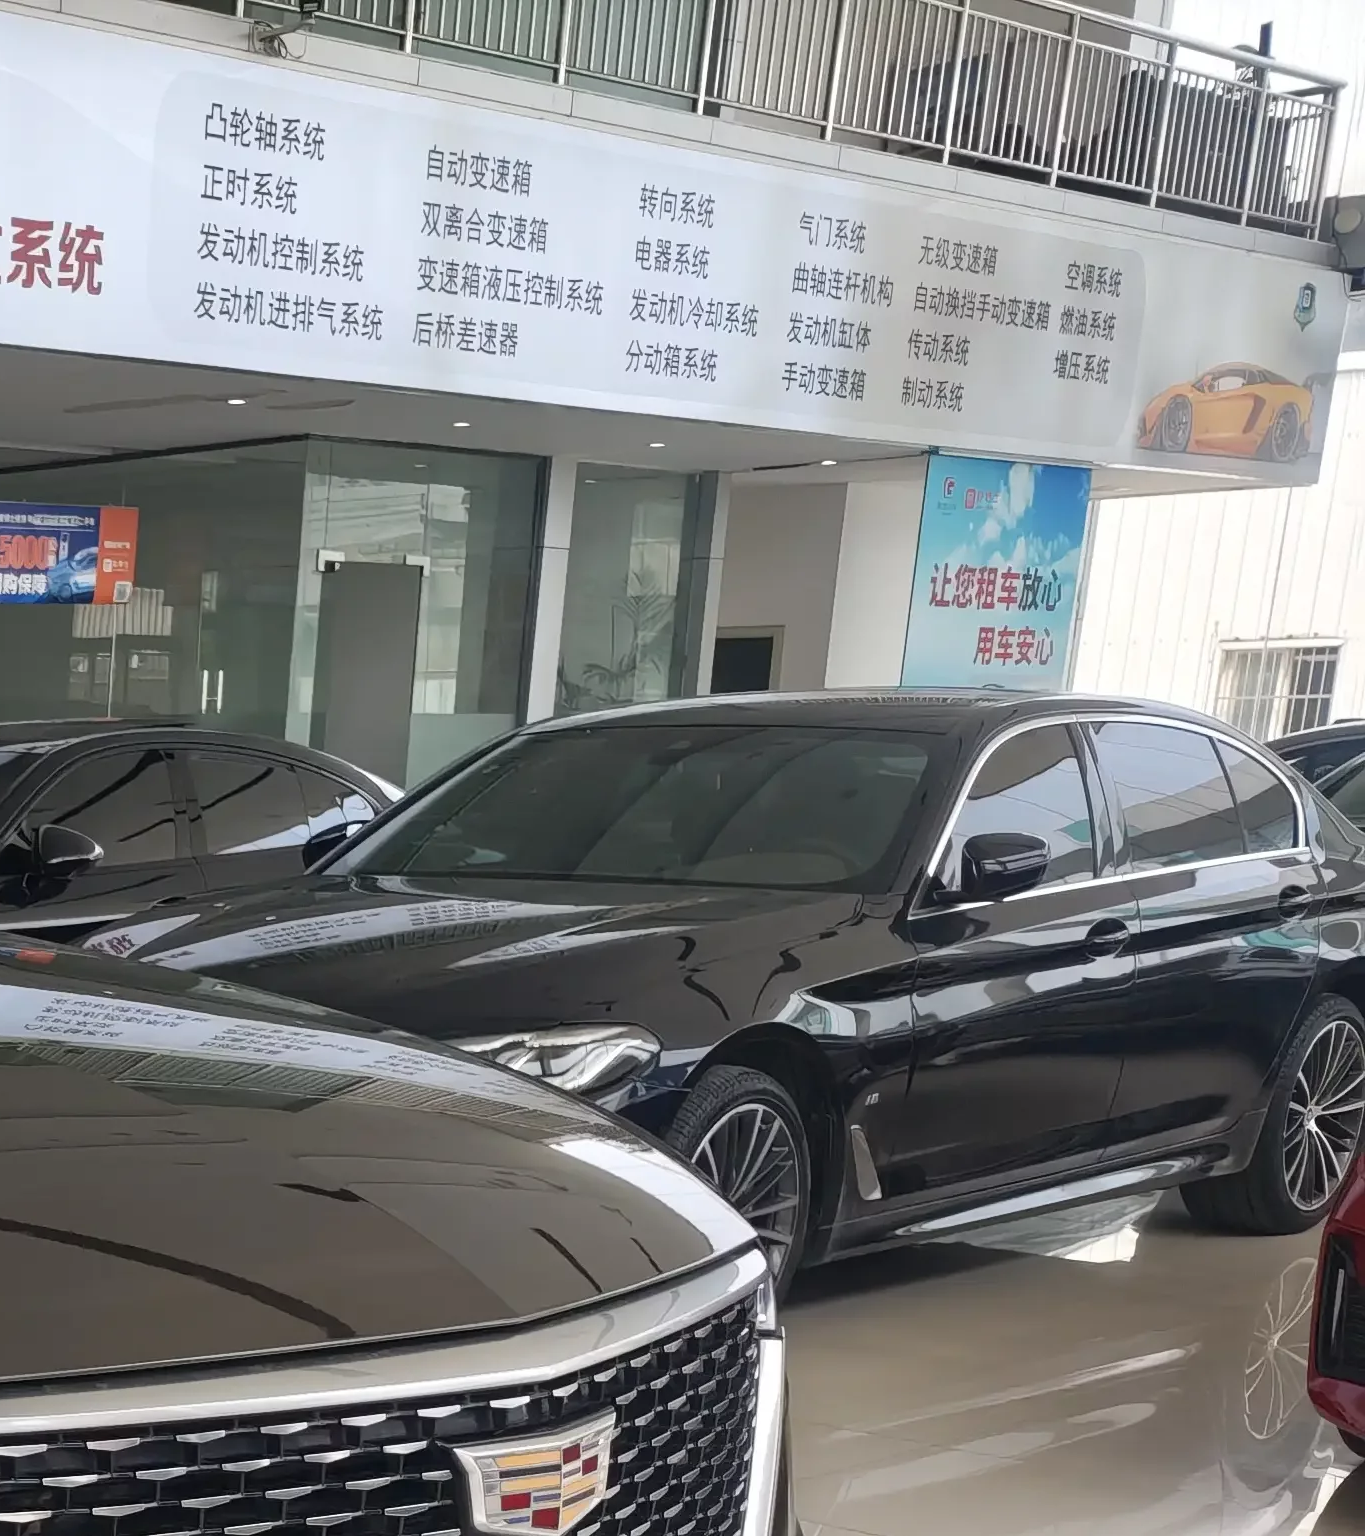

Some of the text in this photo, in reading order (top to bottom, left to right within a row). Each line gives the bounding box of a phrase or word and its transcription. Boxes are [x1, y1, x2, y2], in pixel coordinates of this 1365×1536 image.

[204, 103, 326, 163] 凸轮轴系统
[201, 165, 298, 216] 正时系统
[425, 145, 533, 198] 自动变速箱
[421, 202, 549, 255] 双离合变速箱
[639, 183, 715, 229] 转向系统
[197, 223, 365, 284] 发动机控制系统
[799, 212, 867, 255] 气门系统
[917, 235, 999, 276] 无级变速箱
[635, 236, 710, 280] 电器系统
[1066, 260, 1122, 299] 空调系统
[417, 257, 604, 317] 变速箱液压控制系统
[791, 262, 895, 308] 曲轴连杆机构
[912, 282, 1052, 333] 自动换挡手动变速箱
[194, 282, 384, 343] 发动机进排气系统
[629, 288, 759, 338] 发动机冷却系统
[786, 312, 872, 353] 发动机缸体
[1058, 305, 1117, 342] 燃油系统
[412, 313, 519, 359] 后桥差速器
[907, 329, 971, 367] 传动系统
[625, 340, 718, 383] 分动箱系统
[781, 361, 866, 403] 手动变速箱
[1053, 349, 1110, 386] 增压系统
[901, 378, 965, 413] 制动系统
[929, 563, 1062, 611] 让您租车放心
[973, 625, 1054, 666] 用车安心
